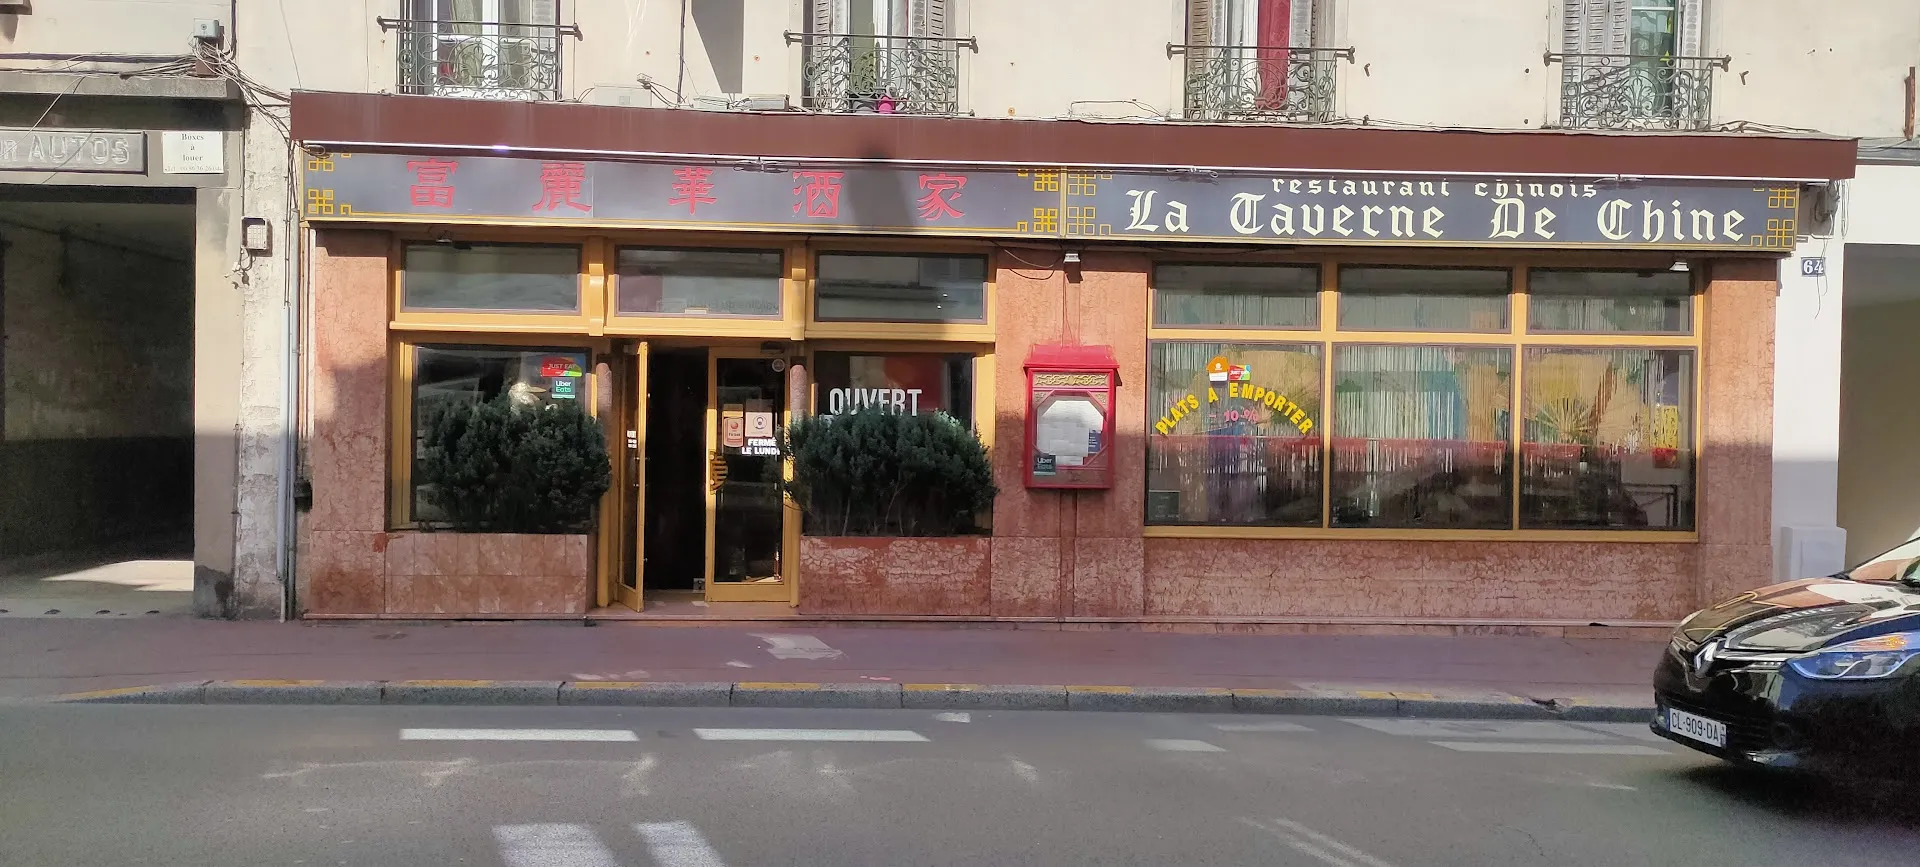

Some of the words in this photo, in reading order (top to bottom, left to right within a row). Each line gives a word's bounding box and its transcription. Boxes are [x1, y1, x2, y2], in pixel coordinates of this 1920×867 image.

[181, 133, 205, 141] Boxes
[28, 134, 130, 165] AUTOS
[182, 154, 204, 162] louer
[1271, 176, 1450, 197] restaurant
[1474, 178, 1597, 199] chinois
[1125, 189, 1190, 233] La
[1230, 192, 1446, 239] Taverne
[1488, 197, 1557, 240] De
[1597, 198, 1745, 243] Chine
[1803, 260, 1824, 274] 64
[829, 387, 922, 417] OUVERT
[1155, 394, 1199, 436] PLATS
[1208, 387, 1219, 404] A
[1229, 382, 1313, 435] EMPORTER
[1223, 409, 1239, 422] 10
[741, 446, 752, 455] LE
[747, 436, 777, 447] FERMÉ
[1671, 712, 1719, 742] CL-909-DA
